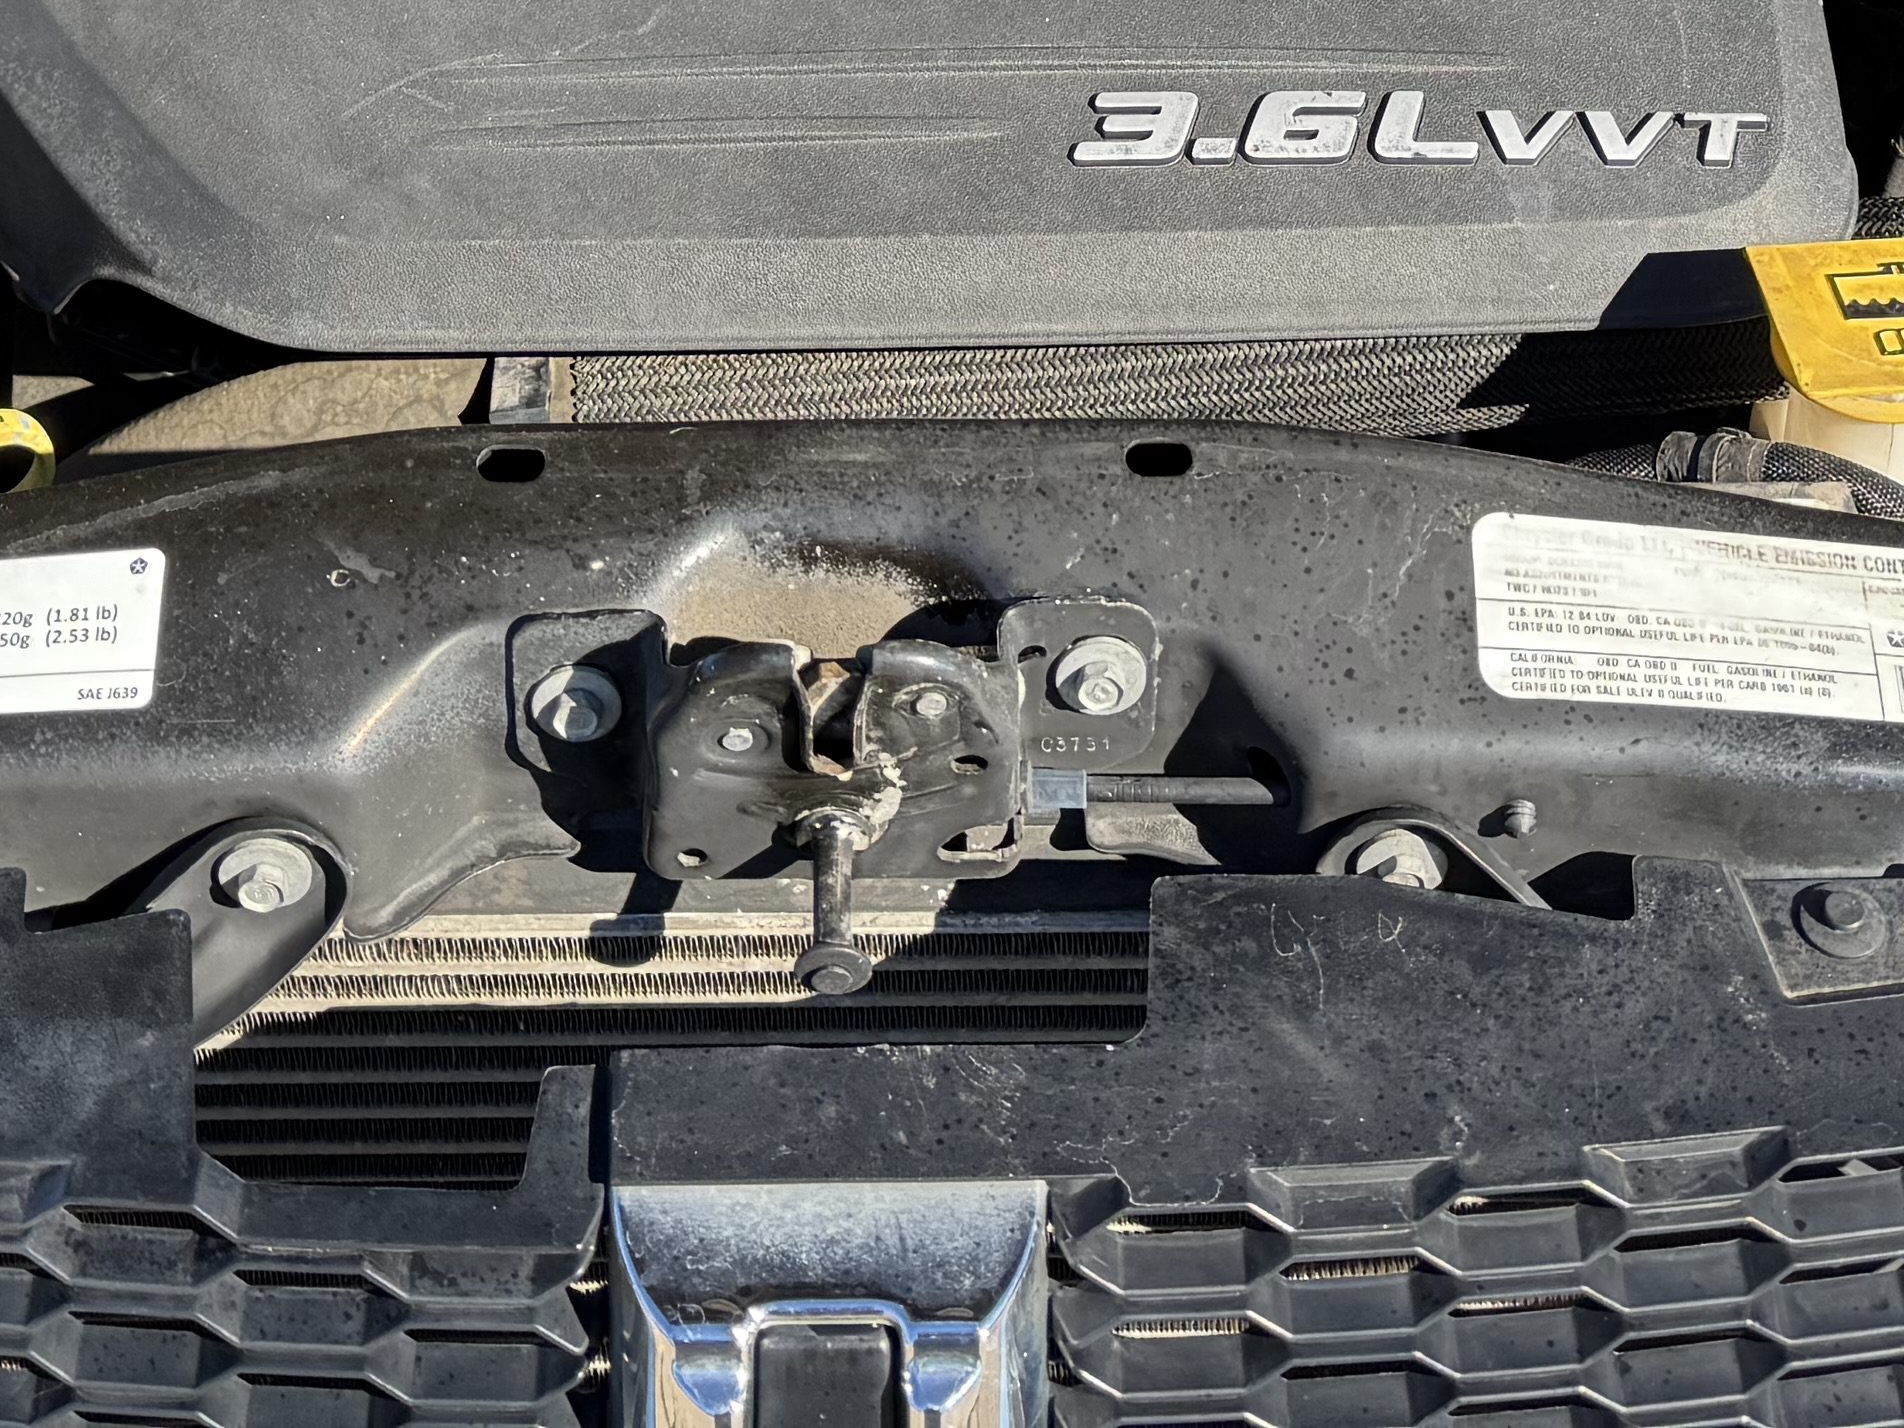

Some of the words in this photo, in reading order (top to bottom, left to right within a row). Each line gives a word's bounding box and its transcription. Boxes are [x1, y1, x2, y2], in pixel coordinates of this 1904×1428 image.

[1068, 89, 1480, 170] 3.6L
[1478, 109, 1772, 170] VVT
[46, 607, 91, 626] (1.81
[95, 603, 119, 622] lb)
[45, 628, 90, 648] (2.53
[95, 625, 118, 644] lb)
[1508, 621, 1563, 633] CERTIFIED
[1568, 623, 1580, 634] TO
[1584, 624, 1636, 638] OPTIONAL
[1639, 629, 1680, 642] USEFUL
[1511, 667, 1566, 679] CERTIFIED
[1570, 669, 1584, 680] TO
[1587, 670, 1639, 683] OPTIONAL
[1643, 674, 1684, 685] USEFUL
[1687, 677, 1709, 688] LIFE
[1714, 679, 1734, 689] PER
[1626, 659, 1641, 669] CA
[1645, 659, 1666, 670] OBD
[1726, 665, 1778, 679] GASOLINE
[1790, 670, 1838, 684] ETHANOL
[77, 687, 104, 701] SAE
[106, 686, 139, 700] J639
[1511, 681, 1567, 693] CERTIFIED
[1571, 684, 1591, 695] FOR
[1596, 685, 1621, 696] SALE
[1040, 736, 1110, 753] C3731
